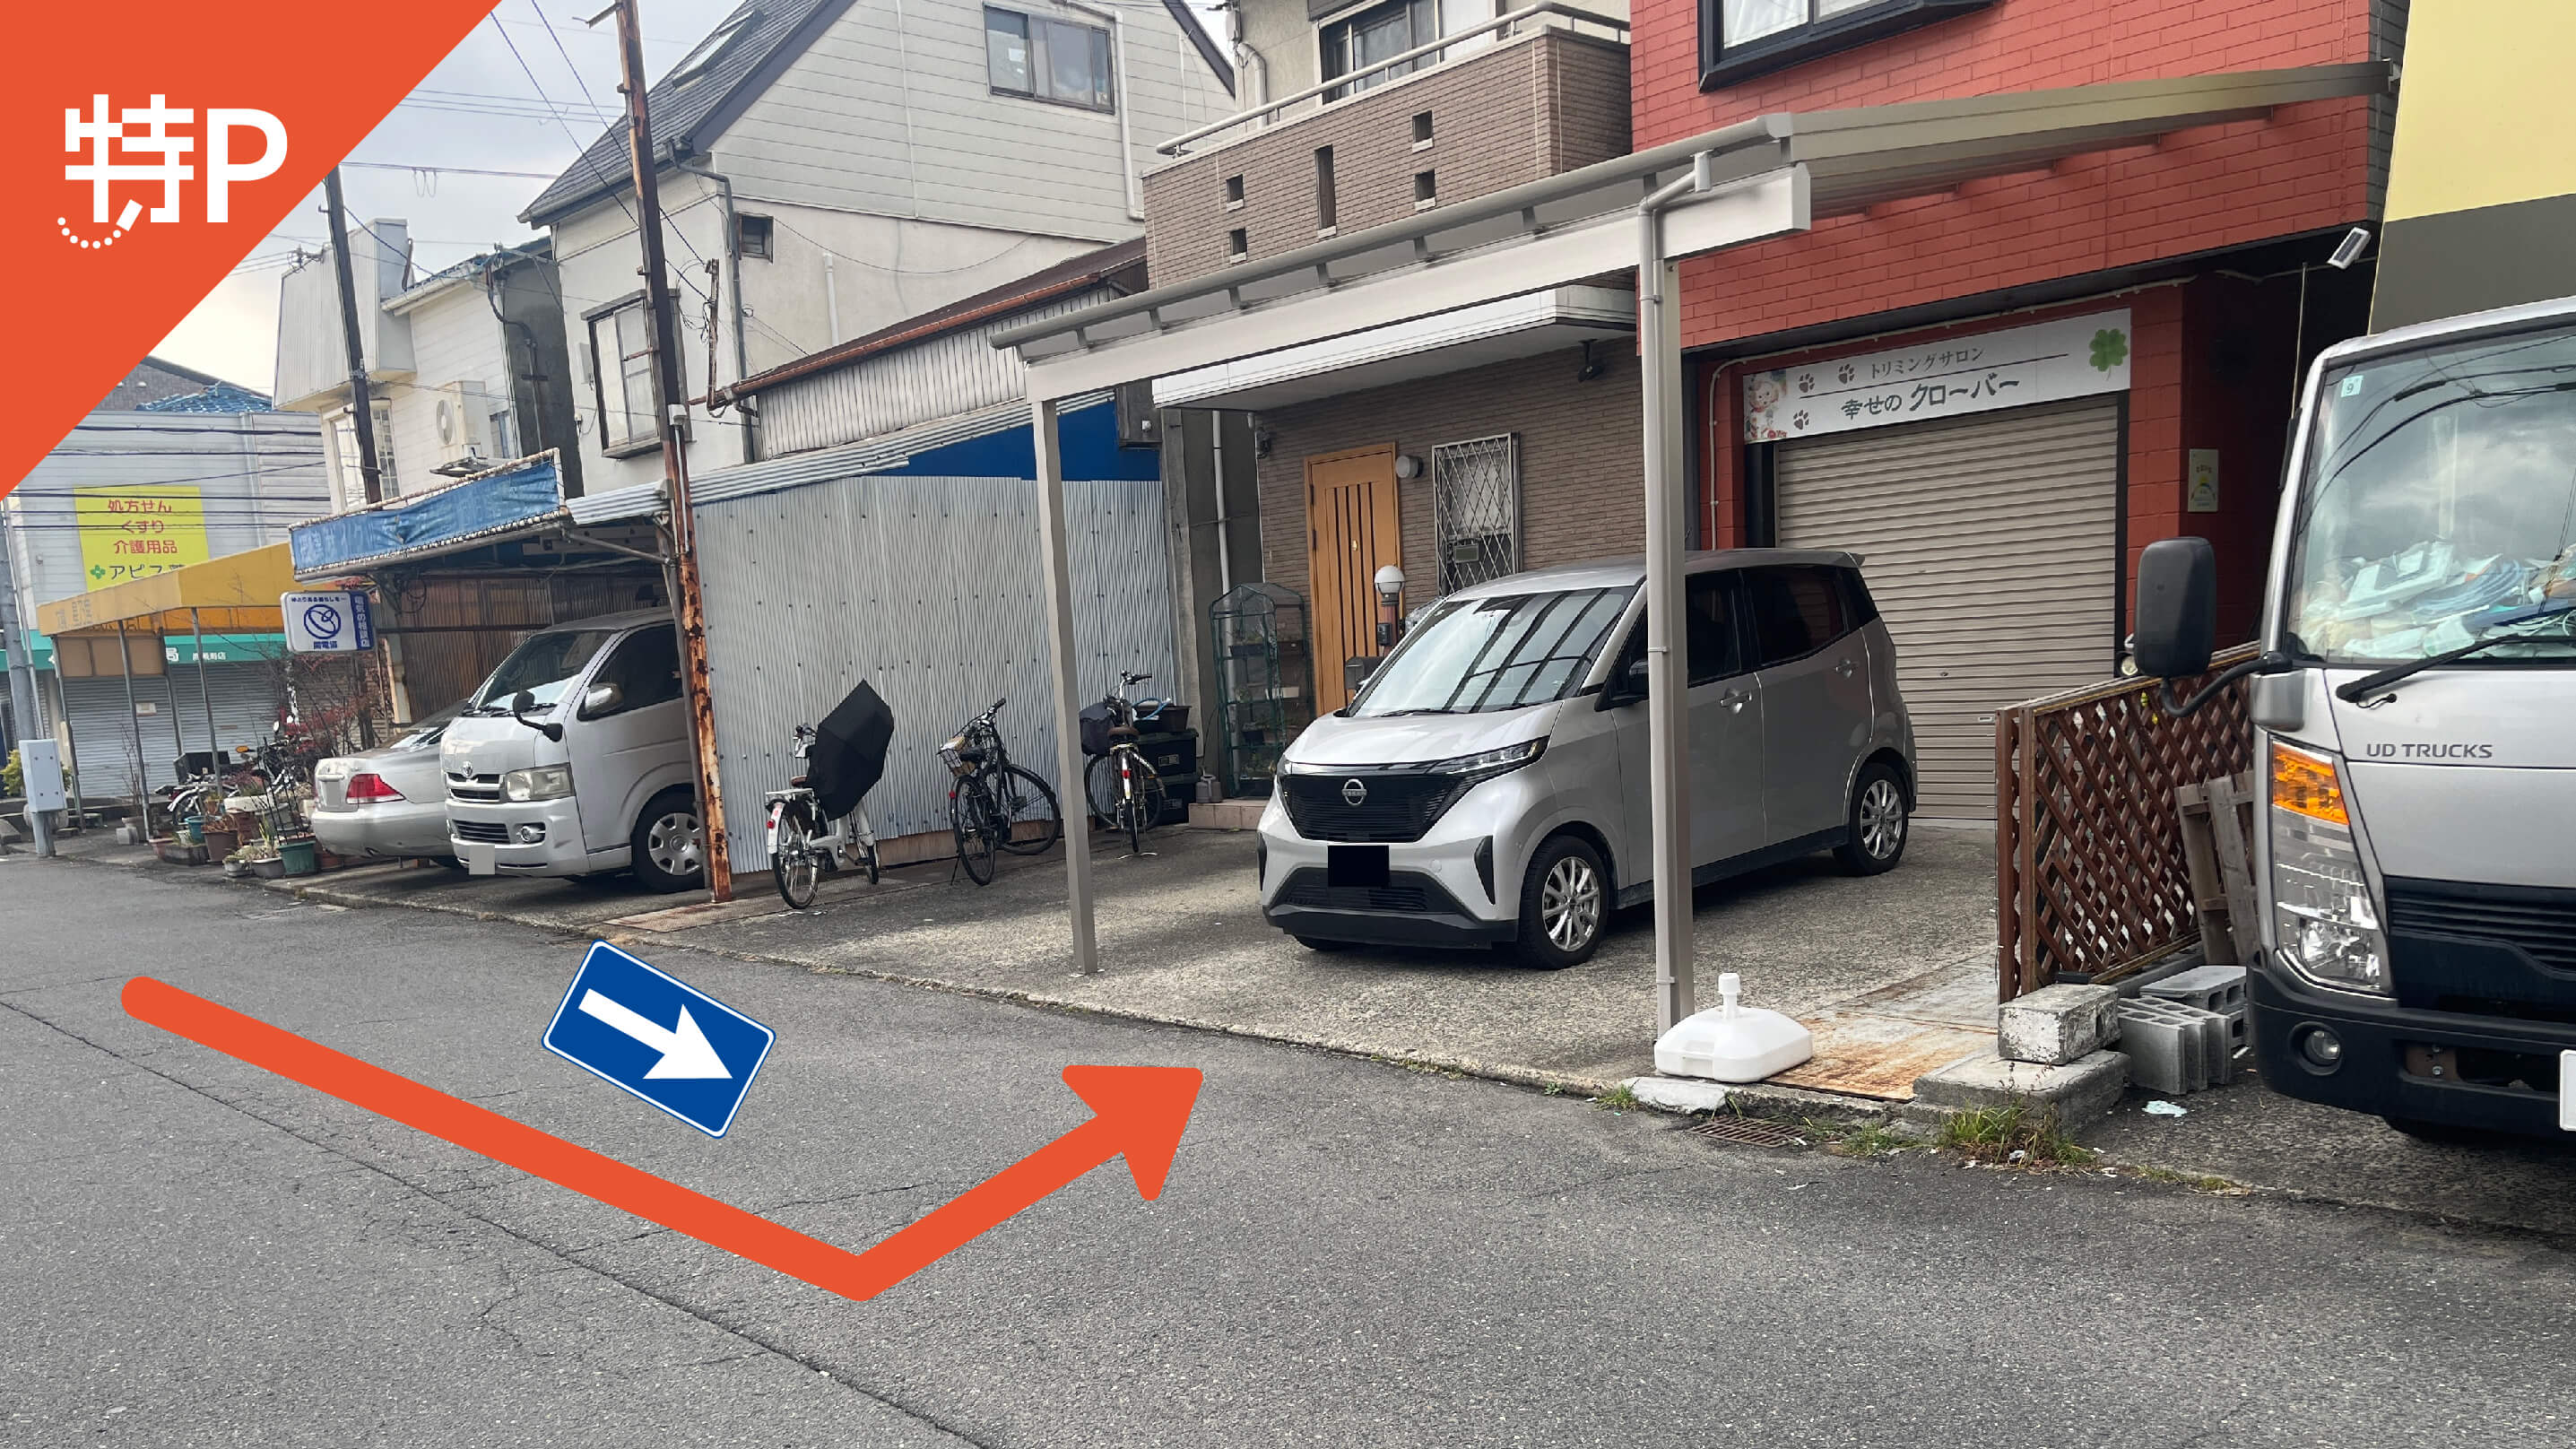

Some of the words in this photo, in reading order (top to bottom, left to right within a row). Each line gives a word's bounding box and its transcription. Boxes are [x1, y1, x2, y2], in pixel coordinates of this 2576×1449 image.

[1871, 347, 1985, 379] トリミングサロン
[108, 499, 172, 514] 処方せん
[122, 519, 164, 534] くすり
[113, 540, 178, 555] 介護用品
[2366, 743, 2397, 757] UD
[2401, 743, 2494, 759] TRUCKS
